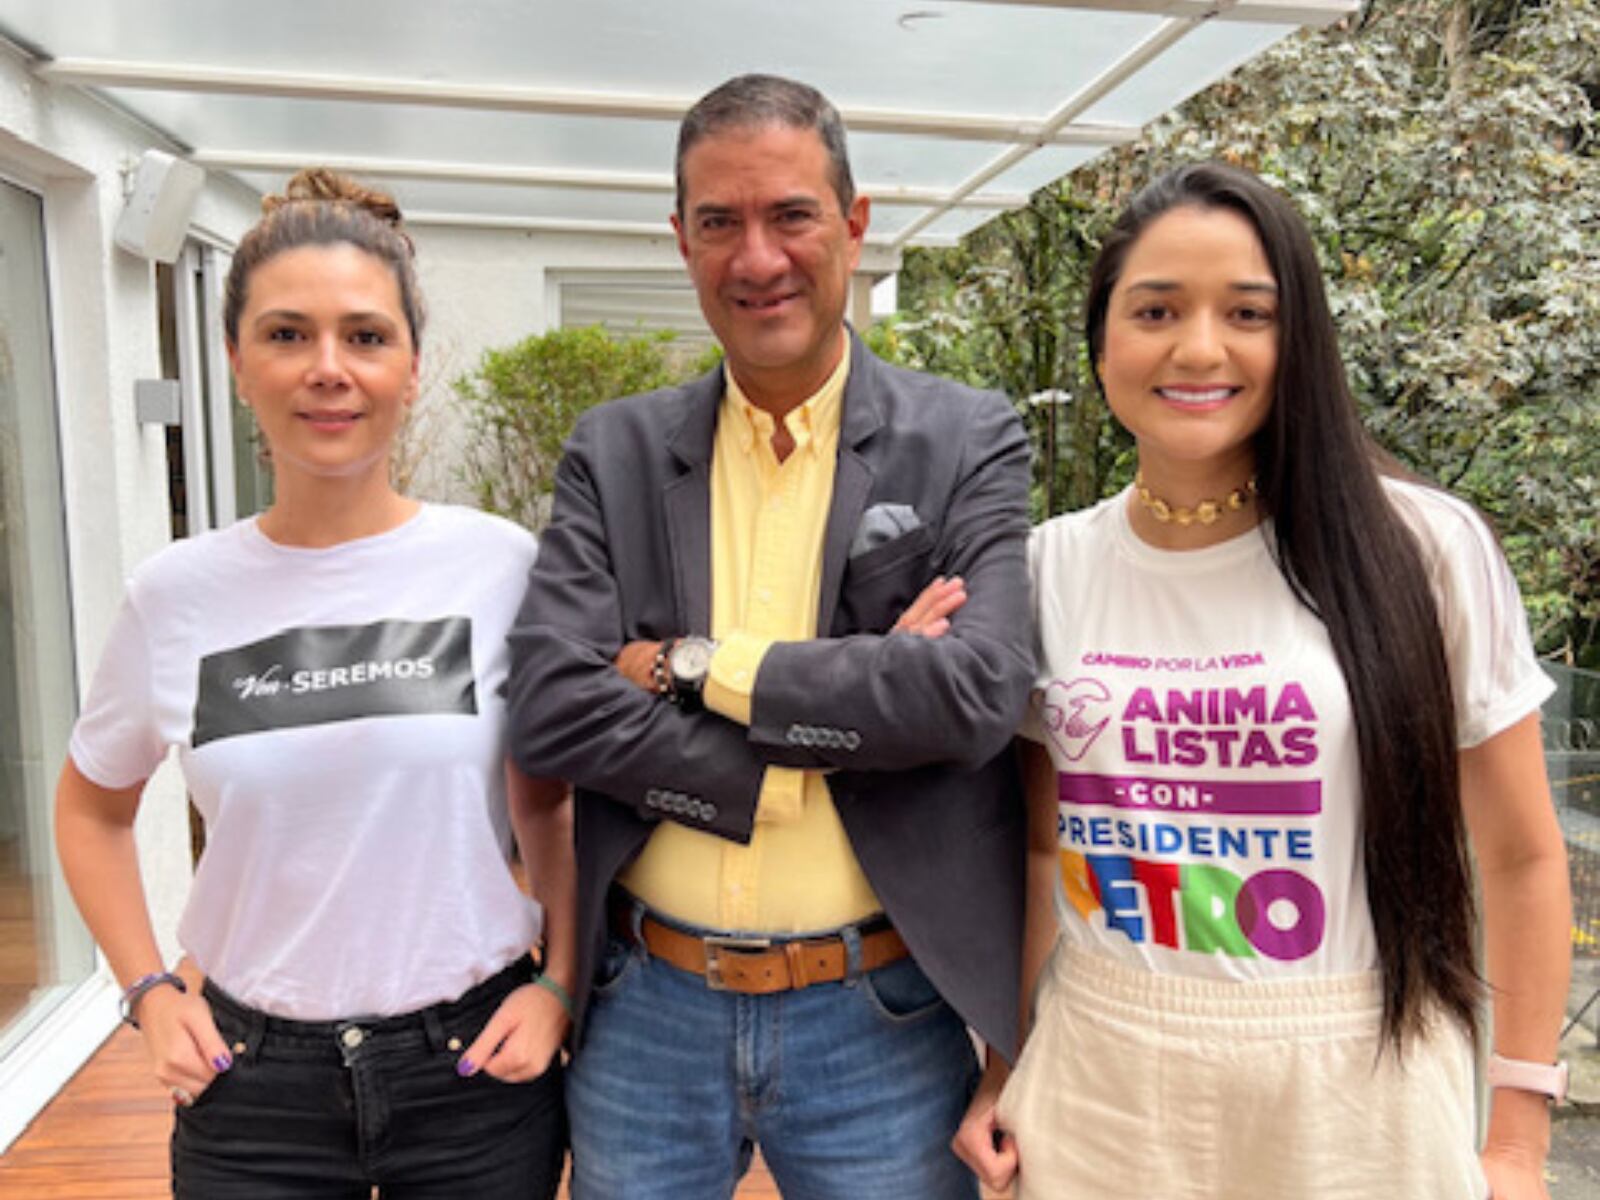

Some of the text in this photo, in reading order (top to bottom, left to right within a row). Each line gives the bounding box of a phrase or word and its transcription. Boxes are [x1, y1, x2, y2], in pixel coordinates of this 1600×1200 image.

[291, 657, 434, 694] SEREMOS
[1155, 656, 1193, 672] POR
[1195, 656, 1219, 672] LA
[1220, 650, 1264, 669] VIDA
[1122, 681, 1317, 725] ANIMA
[1121, 726, 1319, 768] LISTAS
[1058, 848, 1325, 961] PETRO
